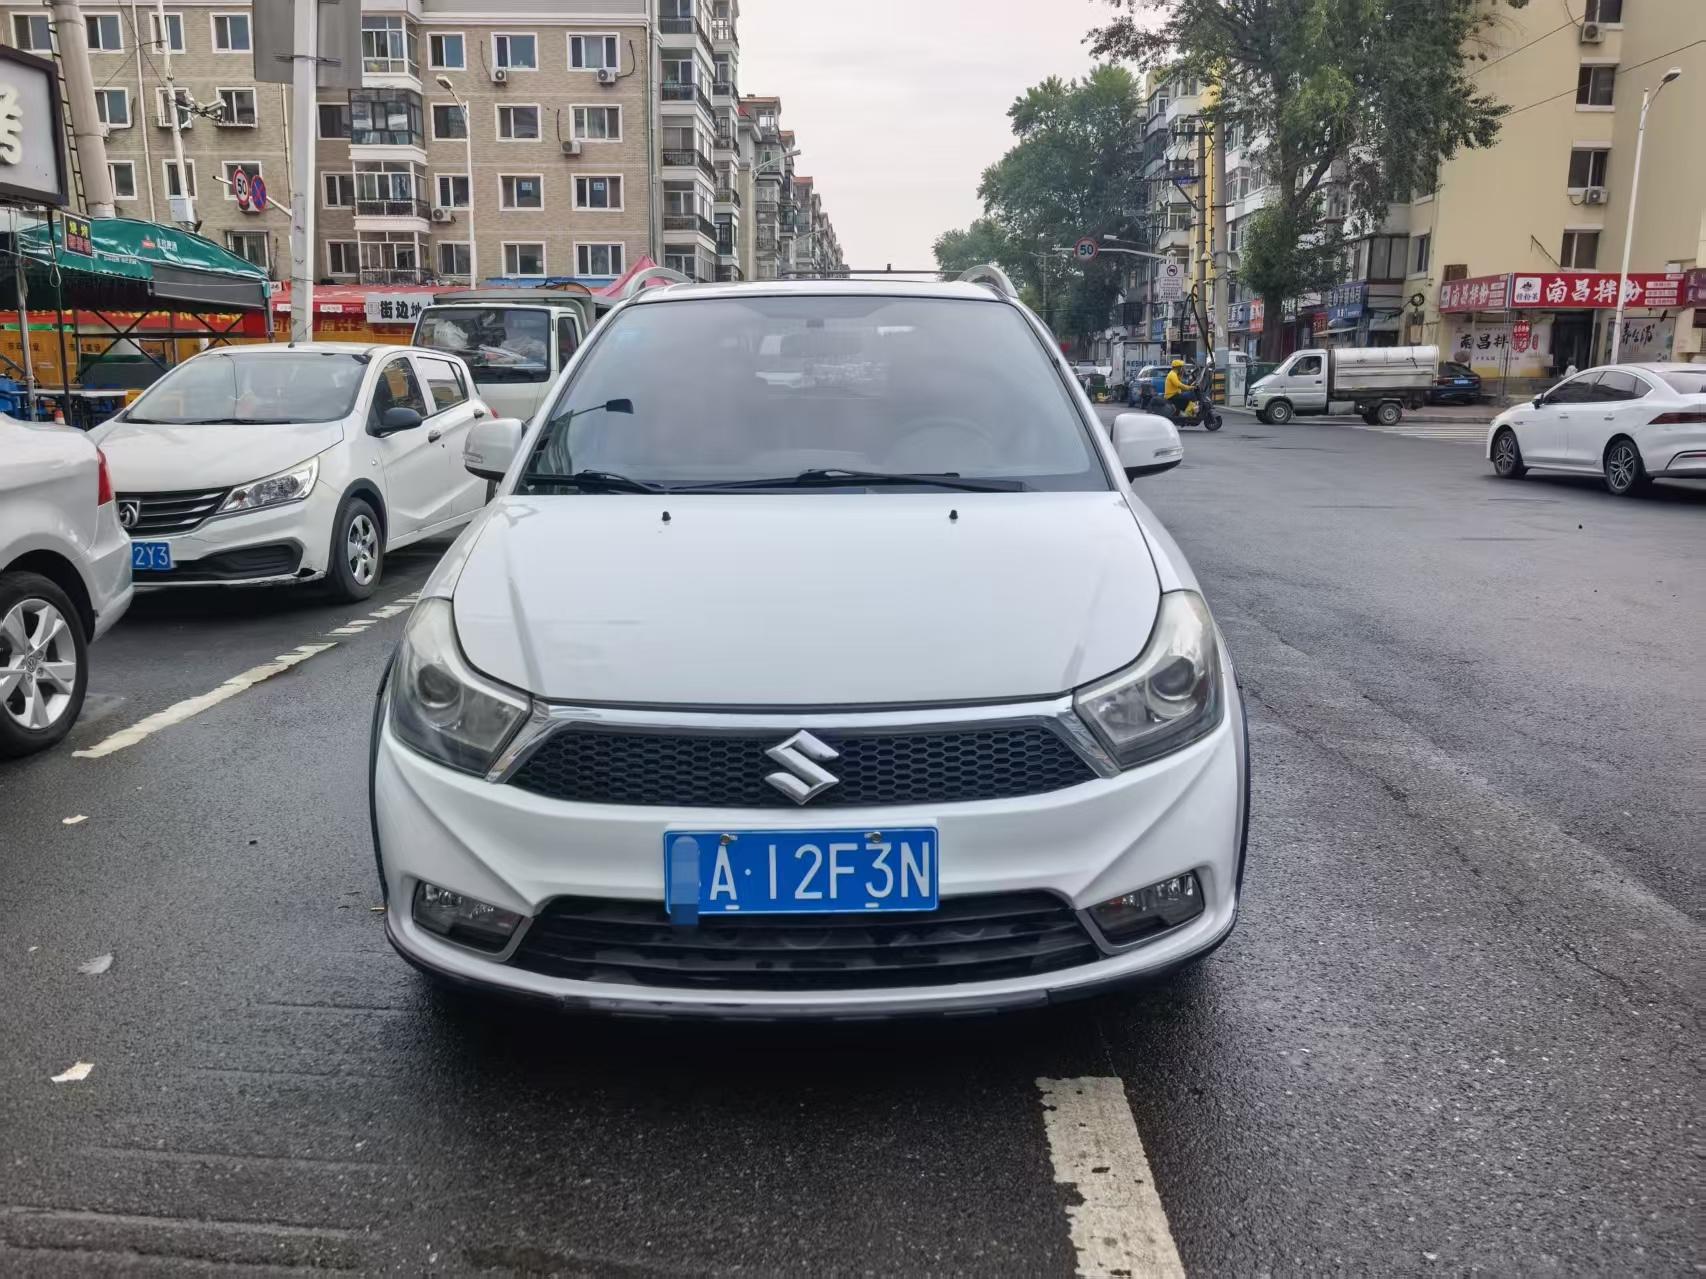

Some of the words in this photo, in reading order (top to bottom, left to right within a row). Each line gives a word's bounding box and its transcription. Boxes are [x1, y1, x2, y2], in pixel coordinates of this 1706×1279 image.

[237, 178, 247, 195] 50
[1079, 244, 1094, 256] 50
[1450, 281, 1490, 307] 南昌拌粉
[1546, 278, 1644, 303] 南昌拌粉
[380, 300, 433, 319] 街边地
[676, 840, 931, 902] A·12F3N
